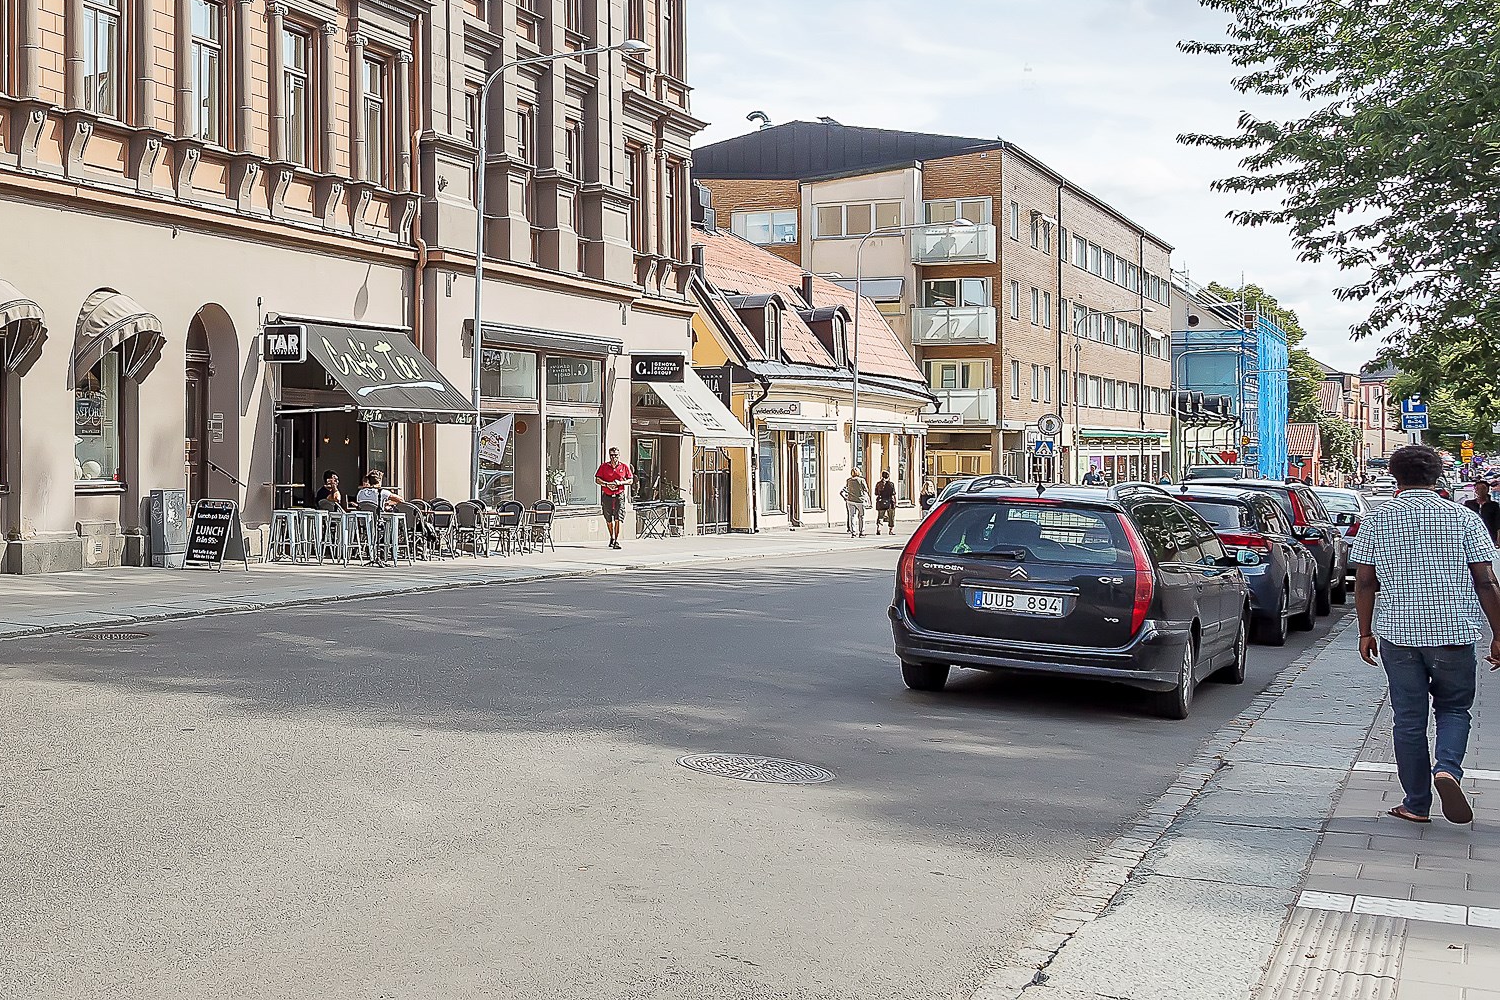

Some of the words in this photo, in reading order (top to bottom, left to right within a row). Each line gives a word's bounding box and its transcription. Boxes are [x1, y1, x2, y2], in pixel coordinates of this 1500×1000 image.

[267, 334, 299, 355] TAR
[195, 524, 225, 537] LUNCH
[983, 592, 1015, 608] UUB
[1027, 597, 1059, 612] 894
